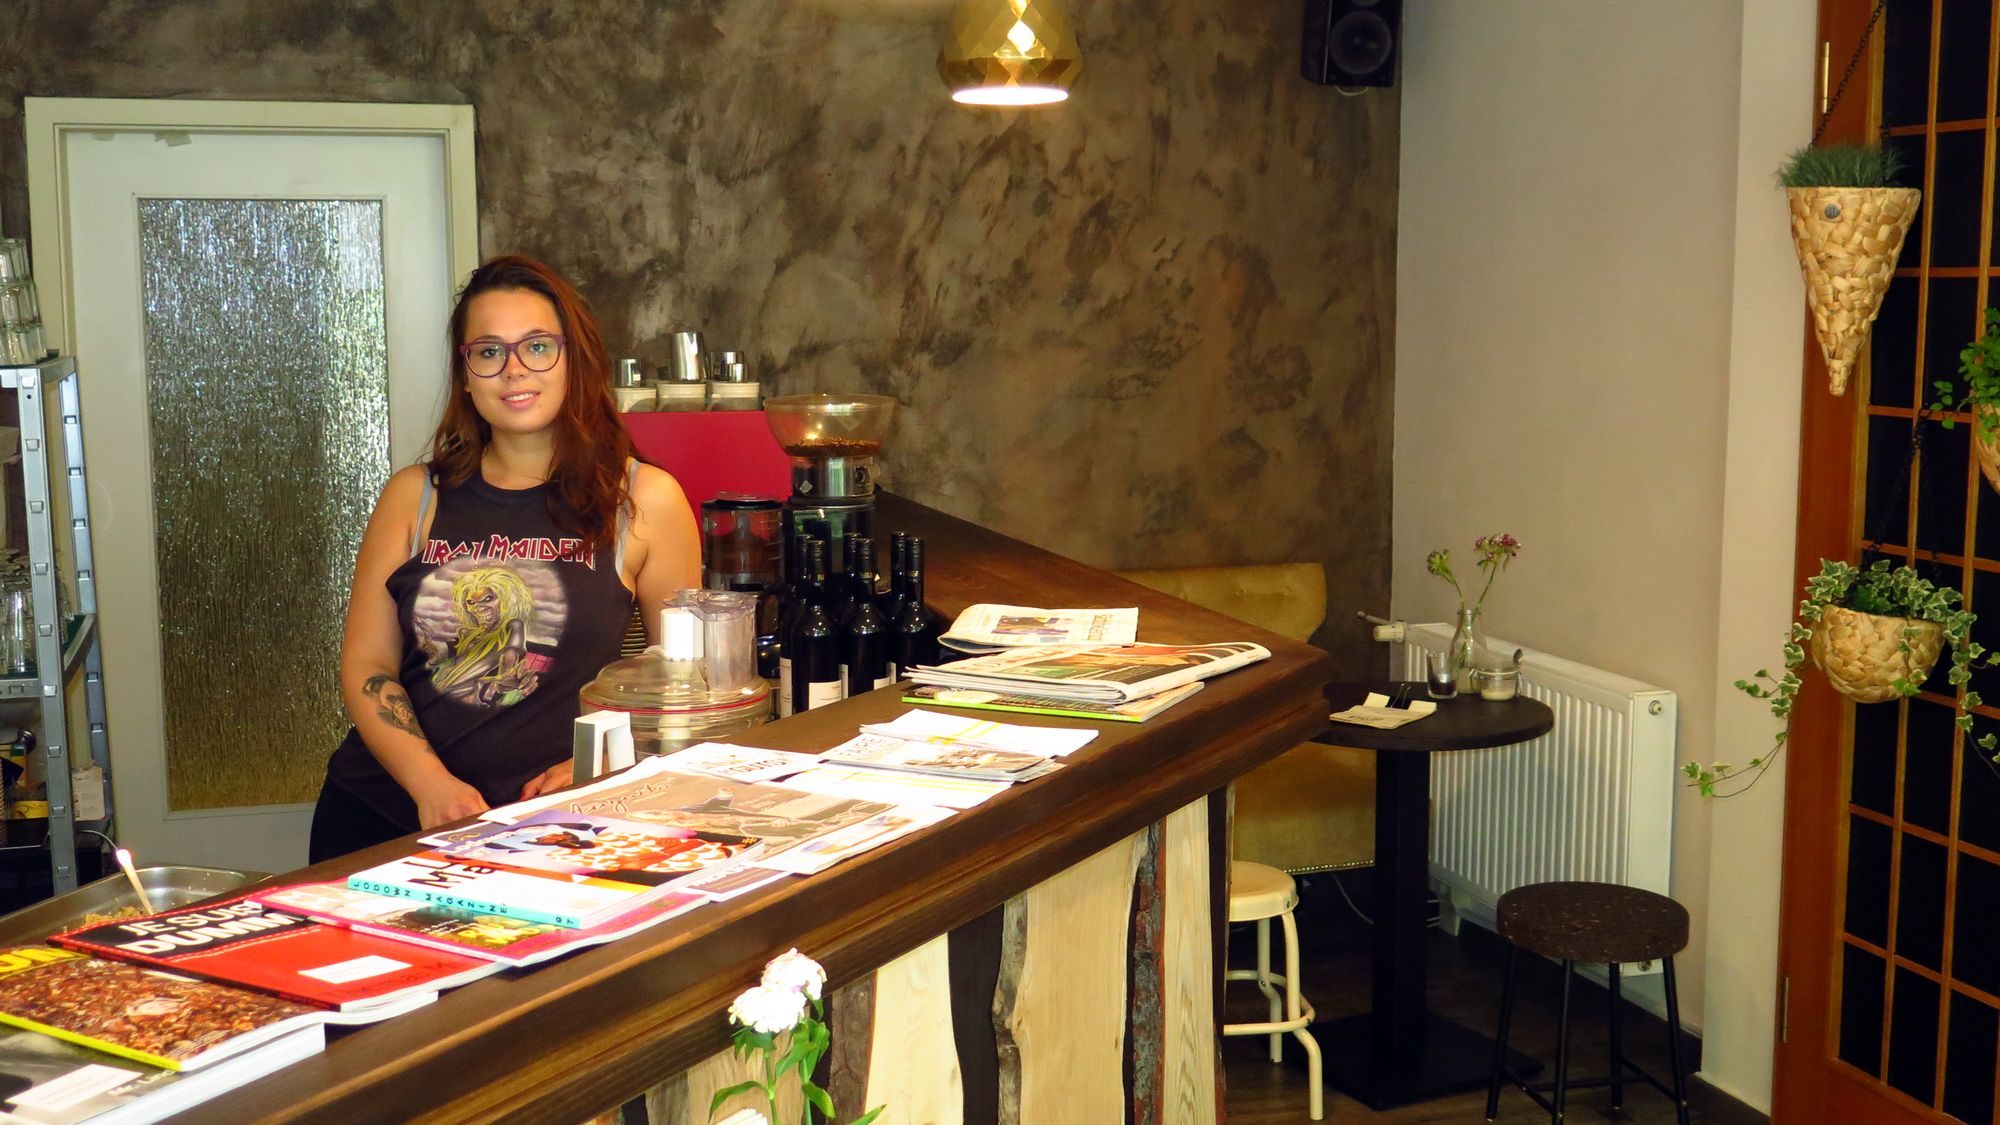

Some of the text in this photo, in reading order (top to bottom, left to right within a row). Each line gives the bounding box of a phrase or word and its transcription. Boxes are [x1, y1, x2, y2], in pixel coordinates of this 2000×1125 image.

[487, 534, 594, 570] MAIDEN
[353, 881, 411, 898] LODOWN
[424, 892, 508, 914] MAGAZINE
[118, 920, 177, 936] JE
